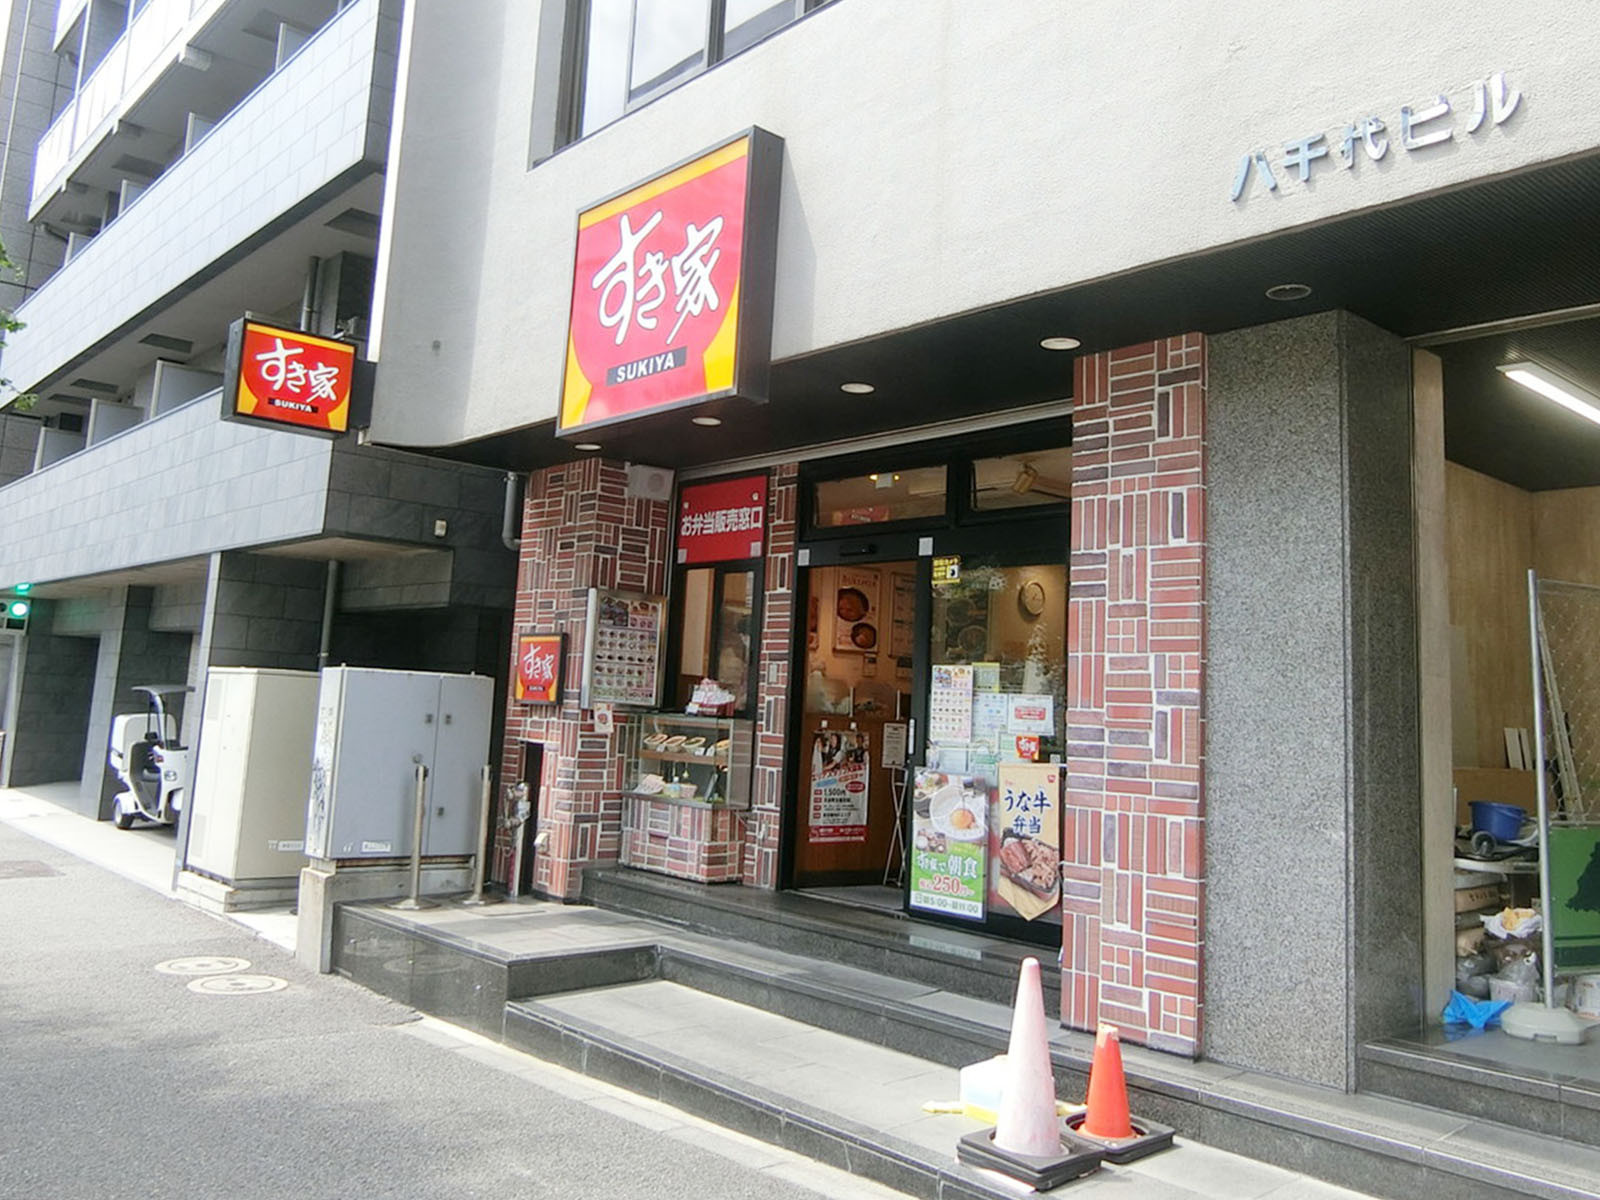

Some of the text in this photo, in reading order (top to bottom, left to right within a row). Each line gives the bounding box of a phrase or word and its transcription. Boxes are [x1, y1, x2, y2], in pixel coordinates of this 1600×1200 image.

[1230, 71, 1523, 202] 八千代ビル
[592, 210, 724, 346] すき家
[256, 338, 339, 403] すき家
[615, 351, 675, 384] SUKIYA
[274, 398, 312, 413] SUKIYA
[681, 506, 763, 536] お弁当販売窓口
[523, 643, 555, 685] すき家
[1004, 788, 1051, 814] うな牛
[1013, 815, 1041, 834] 弁当
